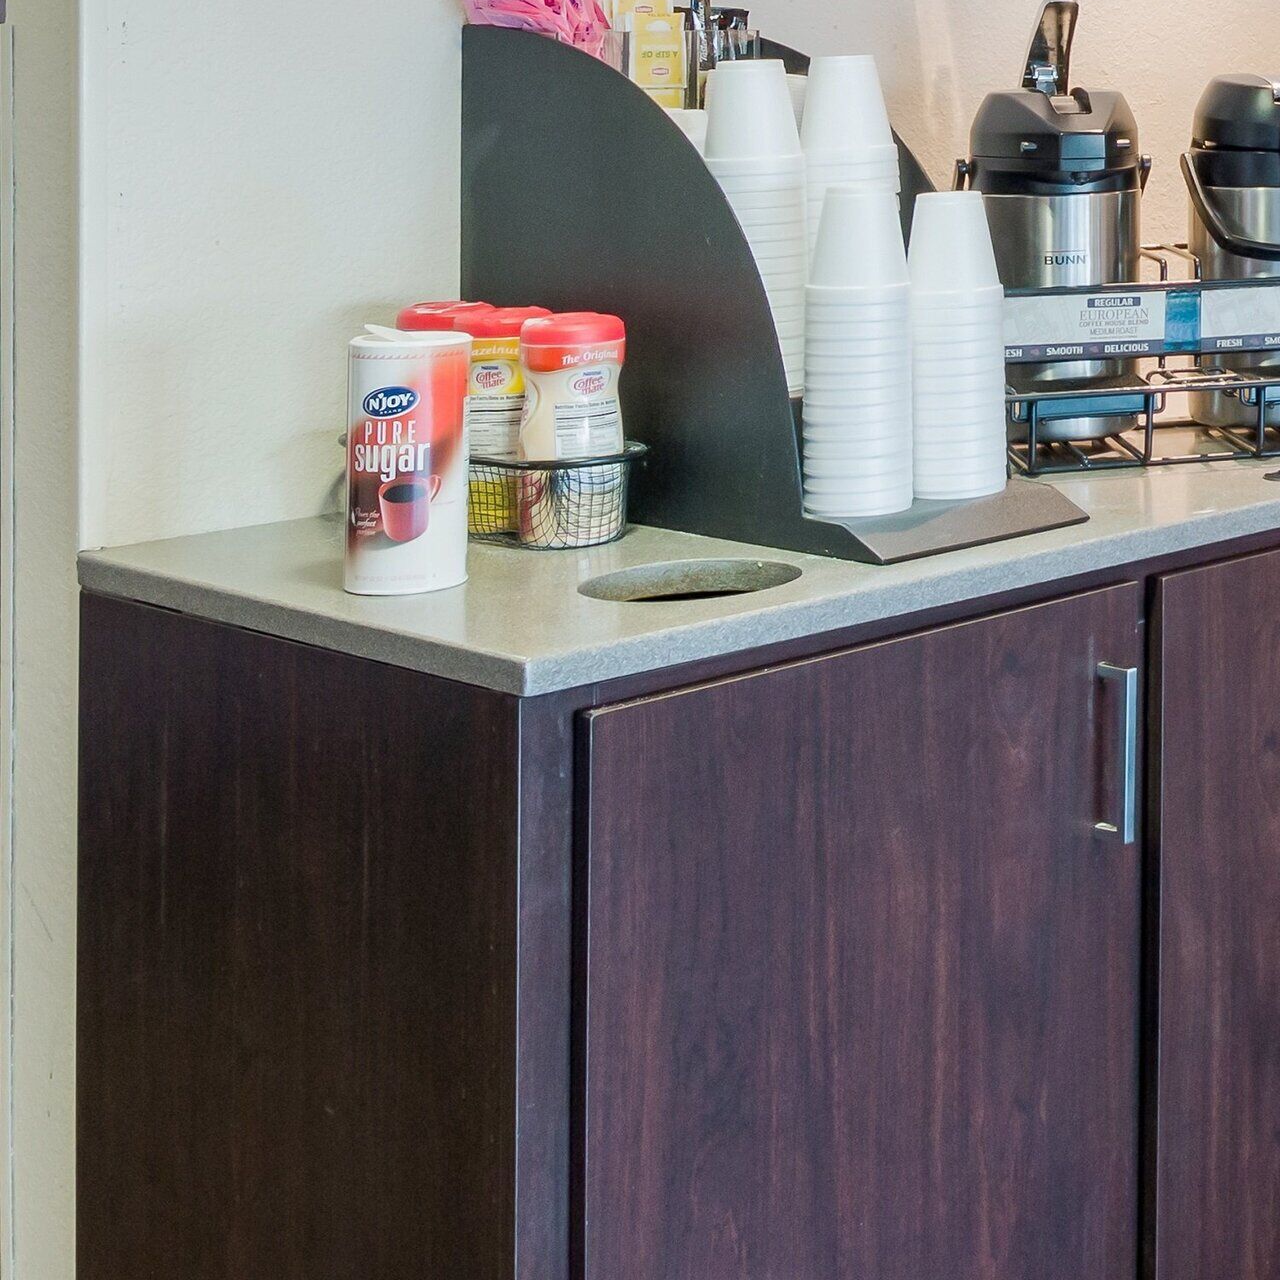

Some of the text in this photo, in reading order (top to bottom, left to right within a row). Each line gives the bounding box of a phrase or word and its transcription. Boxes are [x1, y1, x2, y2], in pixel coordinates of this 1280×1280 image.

[1044, 254, 1087, 266] BUNN
[1094, 297, 1134, 307] REGULAR
[1079, 307, 1150, 321] EUROPEAN
[1216, 338, 1243, 348] FRESH
[471, 345, 519, 356] azelnut
[562, 349, 618, 365] The Original
[1005, 343, 1149, 358] ESH SMOOTH DELICIOUS
[574, 376, 603, 390] Coffee
[365, 420, 416, 444] PURE
[355, 442, 431, 483] sugar
